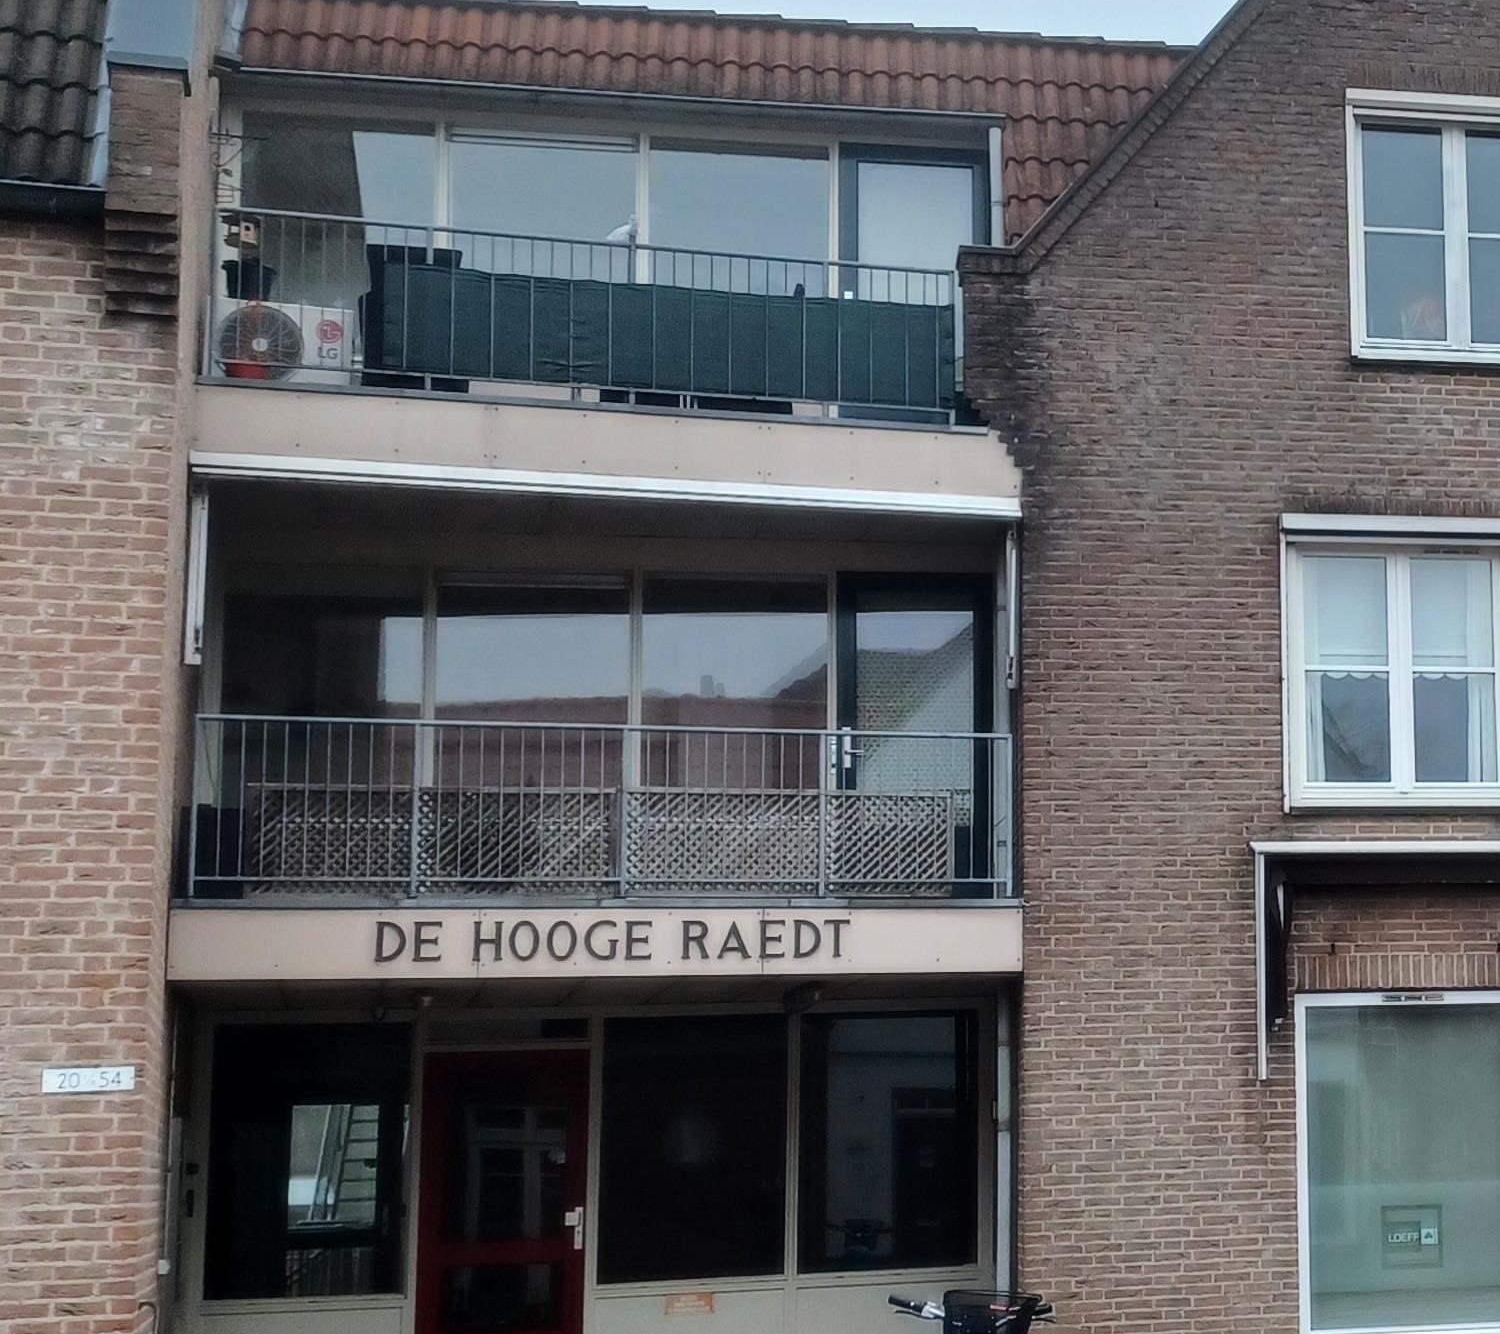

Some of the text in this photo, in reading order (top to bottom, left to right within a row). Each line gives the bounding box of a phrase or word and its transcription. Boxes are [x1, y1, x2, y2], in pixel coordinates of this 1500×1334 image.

[317, 347, 339, 359] LG
[374, 919, 851, 963] DE HOOGE RAEDT
[57, 1071, 81, 1090] 20
[98, 1070, 122, 1089] 54
[1388, 1232, 1420, 1243] LOEFF
